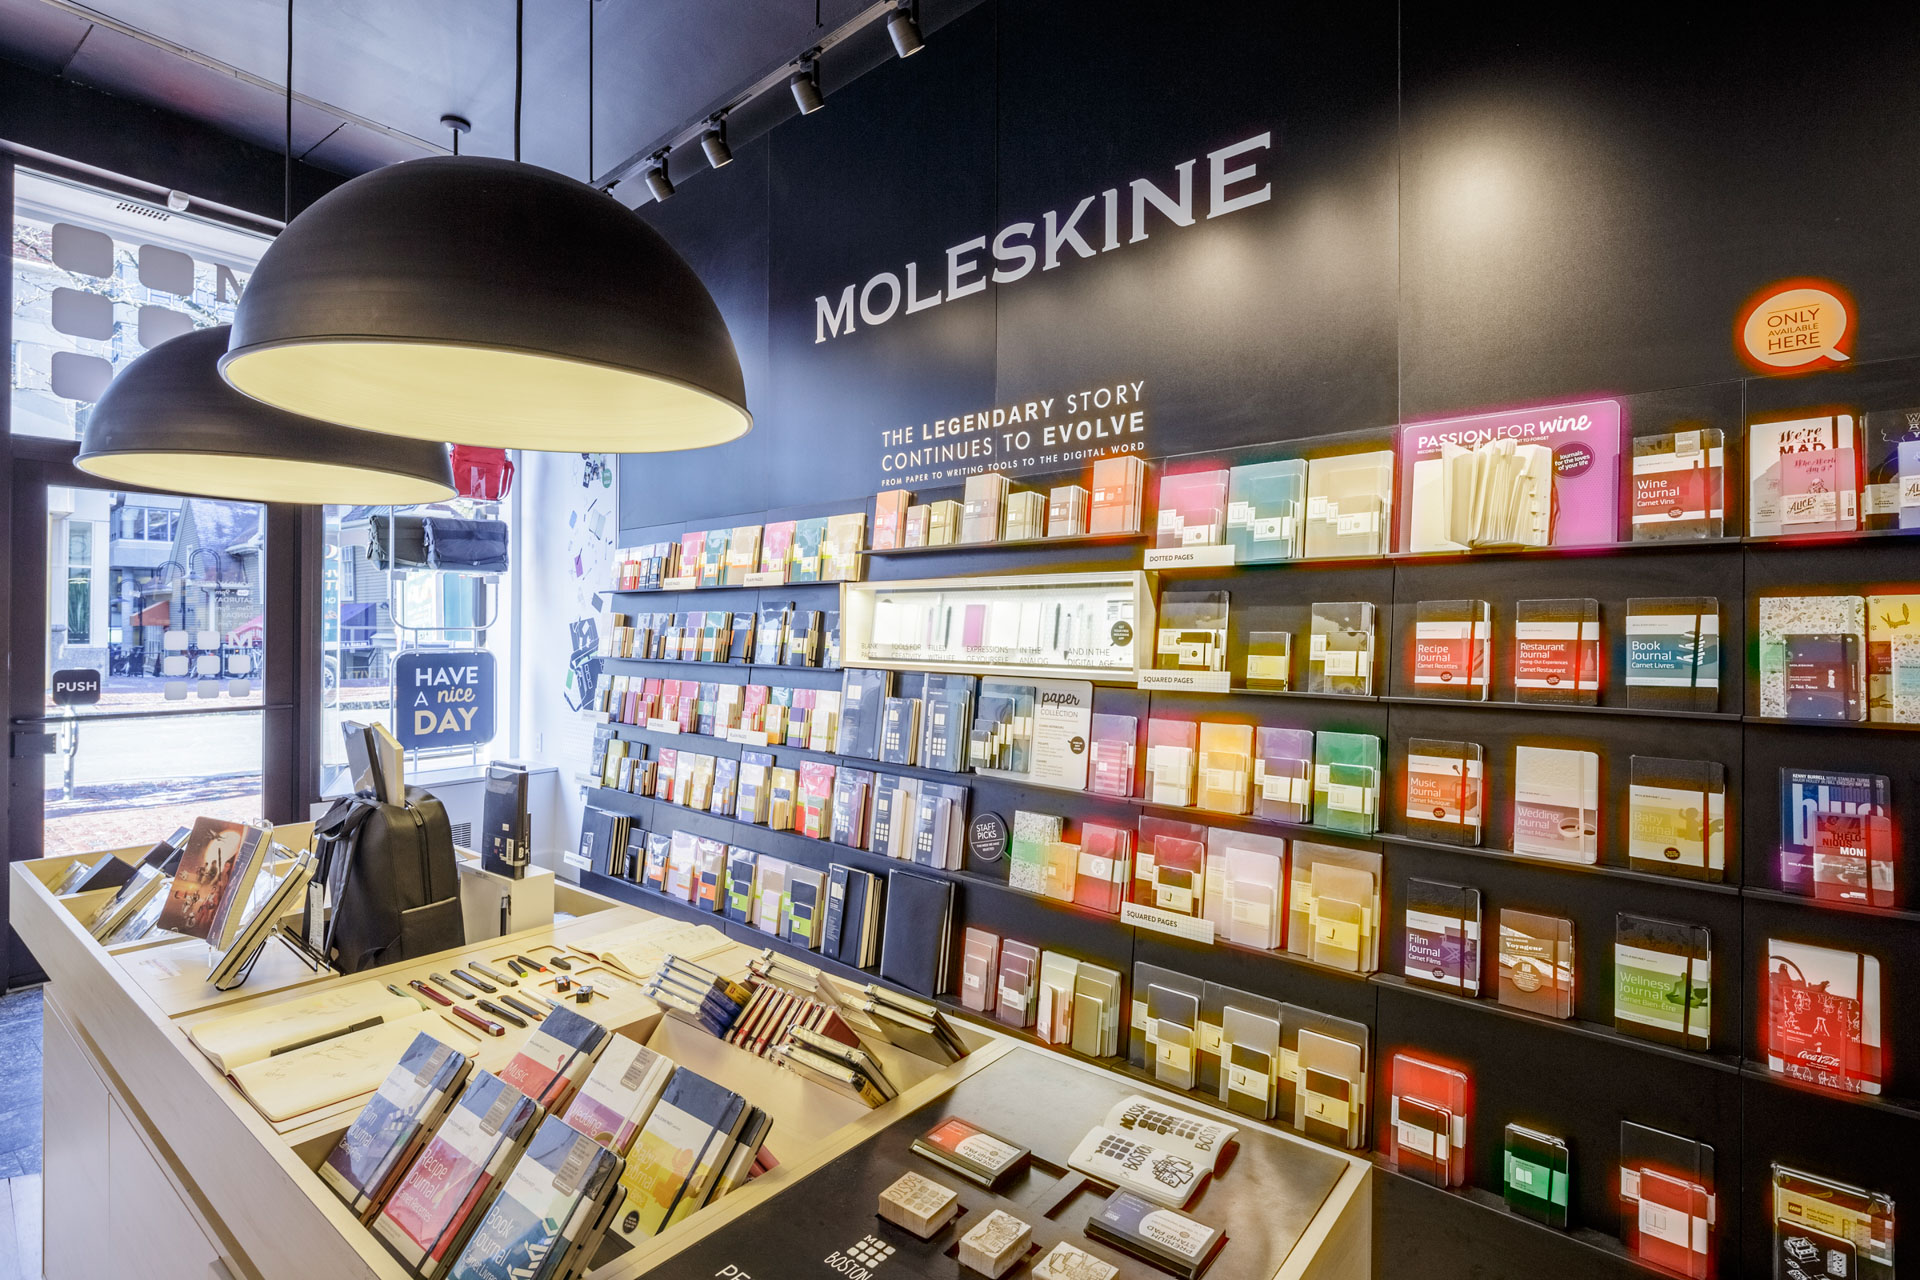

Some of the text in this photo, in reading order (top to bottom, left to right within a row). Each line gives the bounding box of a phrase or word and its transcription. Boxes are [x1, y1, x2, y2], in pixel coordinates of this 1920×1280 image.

[814, 131, 1271, 344] MOLESKINE
[1767, 308, 1820, 328] ONLY
[1768, 323, 1819, 337] AVAILABLE
[1768, 331, 1820, 350] HERE
[882, 380, 1145, 448] THE LEGENDARY STORY
[1418, 414, 1592, 449] PASSION FOR wine
[1778, 426, 1822, 445] We're
[882, 411, 1145, 472] CONTINUES TO EVOLVE
[881, 441, 1145, 487] FROM PAPER TO WRITING TOOLS TO THE DIGITAL WORD
[1637, 480, 1668, 490] Wine
[1637, 486, 1680, 500] Journal
[966, 645, 1009, 654] EXPRESSIONS
[1068, 648, 1110, 656] AND IN THE
[1418, 644, 1449, 655] Recipe
[1520, 642, 1565, 652] Restaurant
[1631, 640, 1661, 650] Book
[1019, 657, 1049, 665] ANALOG
[1417, 653, 1450, 662] Journal
[1520, 650, 1550, 659] Journal
[1631, 651, 1672, 661] Journal
[1067, 659, 1095, 667] DIGITAL
[1536, 666, 1566, 674] Restaurant
[415, 666, 479, 687] HAVE
[56, 681, 97, 692] PUSH
[414, 687, 476, 707] A nice
[1041, 692, 1080, 709] paper
[1040, 708, 1079, 718] COLLECTION
[414, 706, 479, 735] DAY
[1410, 777, 1436, 789] Music
[1410, 786, 1441, 798] Journal
[1517, 807, 1560, 823] Wedding
[1634, 811, 1663, 826] Baby
[976, 822, 996, 832] STAFF
[1516, 817, 1550, 829] Journal
[1633, 823, 1675, 836] Journal
[977, 830, 997, 840] PICKS
[1126, 910, 1178, 928] SQUARED PAGES
[1409, 933, 1429, 946] Film
[1408, 944, 1441, 958] Journal
[1505, 942, 1544, 952] Voyageur
[1408, 953, 1442, 966] Carnet Films
[1619, 971, 1671, 991] Wellness
[1619, 982, 1663, 1001] Journal
[507, 1062, 529, 1083] Music
[632, 1142, 658, 1170] Baby
[1122, 1144, 1156, 1172] BOSTON
[421, 1148, 449, 1181] Recipe
[486, 1206, 515, 1239] Book
[863, 1234, 877, 1245] M
[1146, 1224, 1197, 1250] STAMP PAD
[1150, 1232, 1193, 1255] PREMIUM
[473, 1227, 513, 1267] Journal
[824, 1250, 873, 1280] BOSTON
